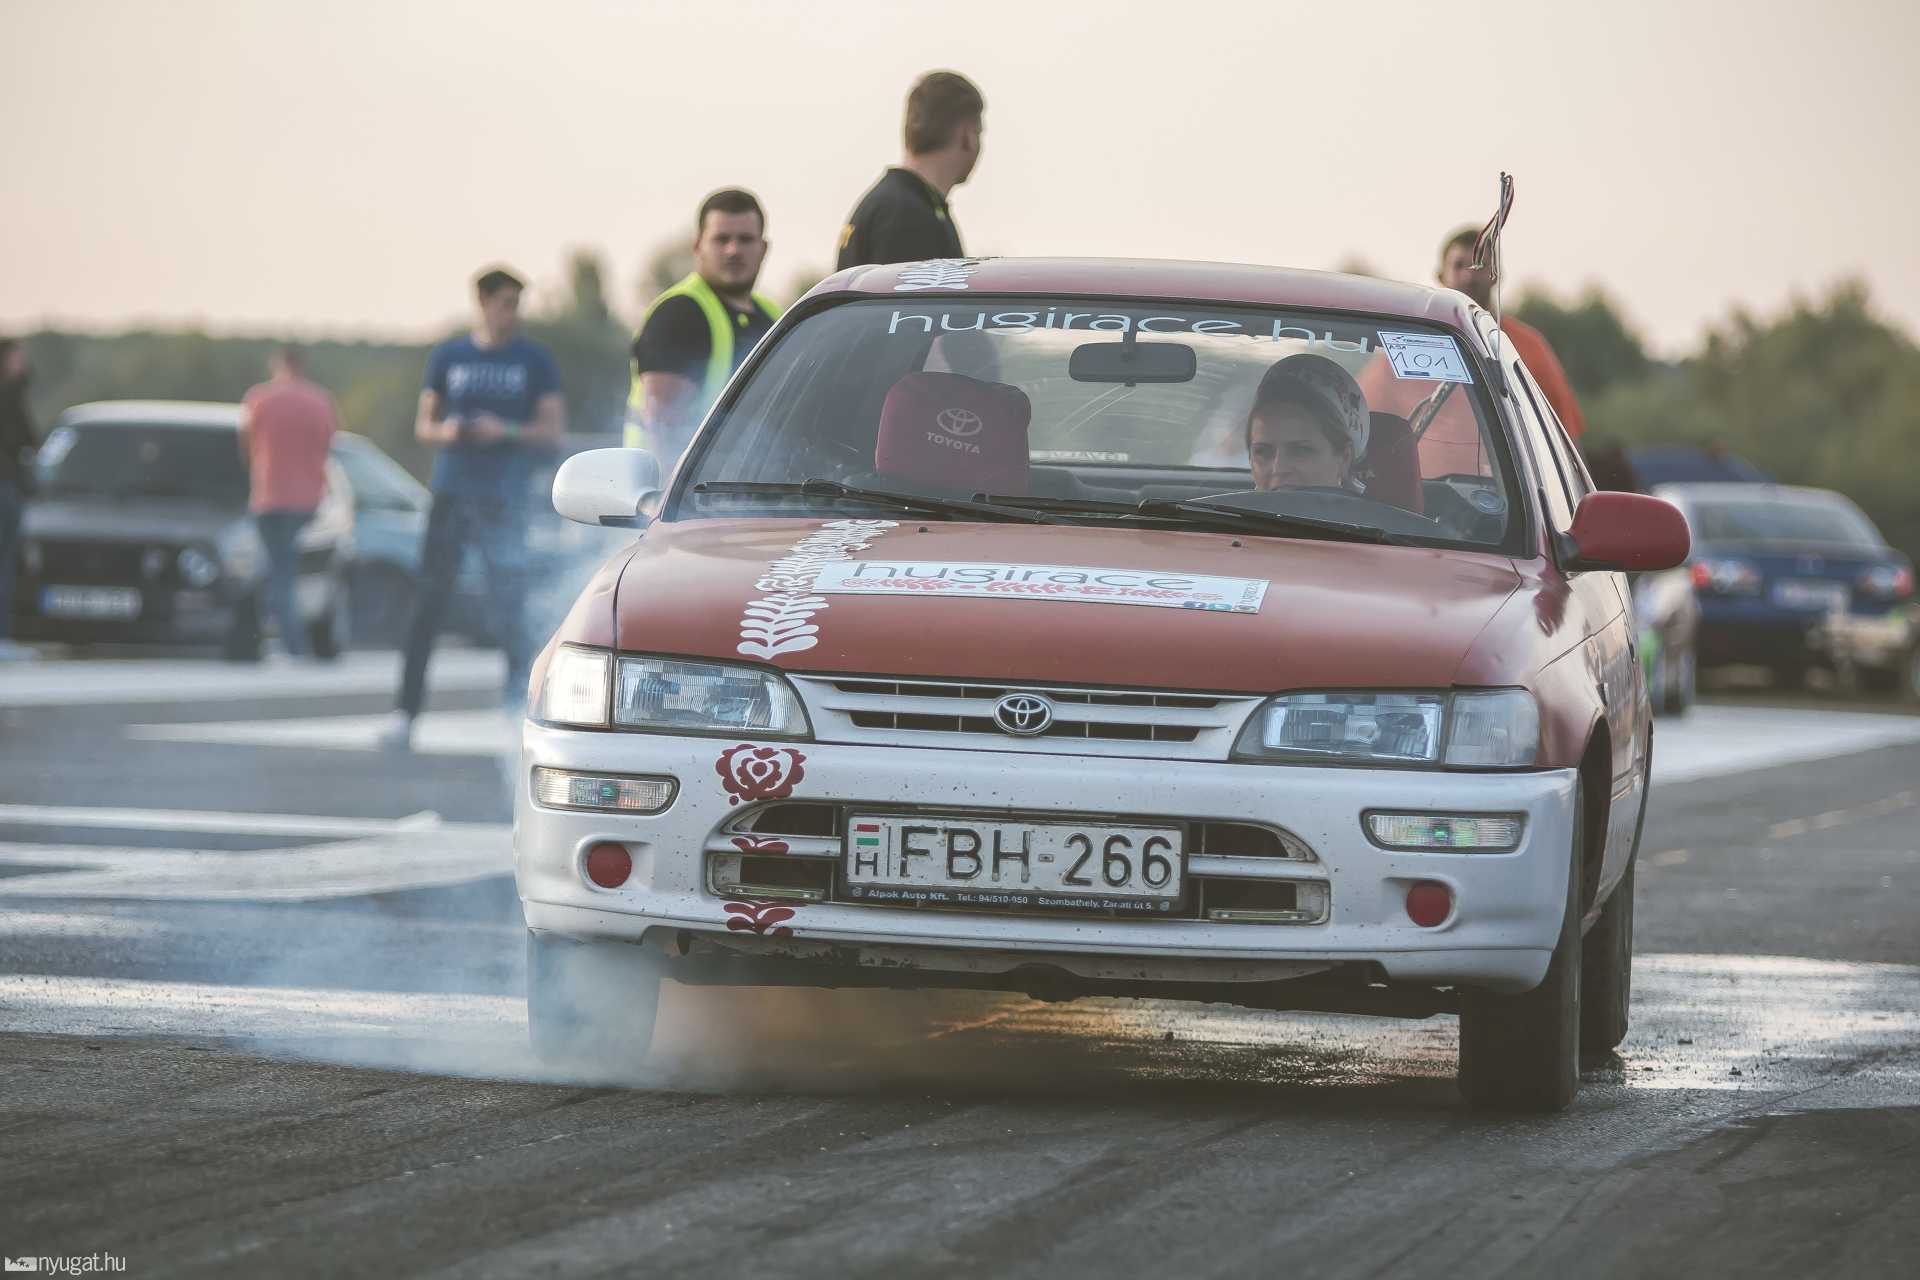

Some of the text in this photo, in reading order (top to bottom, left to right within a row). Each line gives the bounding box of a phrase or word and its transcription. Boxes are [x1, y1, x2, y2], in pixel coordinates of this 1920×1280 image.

[887, 307, 1369, 353] hugirace.hu
[1393, 351, 1449, 370] 101
[924, 431, 981, 455] TOYOTA
[853, 562, 1195, 591] hugirace
[855, 852, 878, 876] H
[899, 825, 1173, 891] FBH-266
[867, 889, 899, 899] Alpok
[901, 890, 927, 900] Auto
